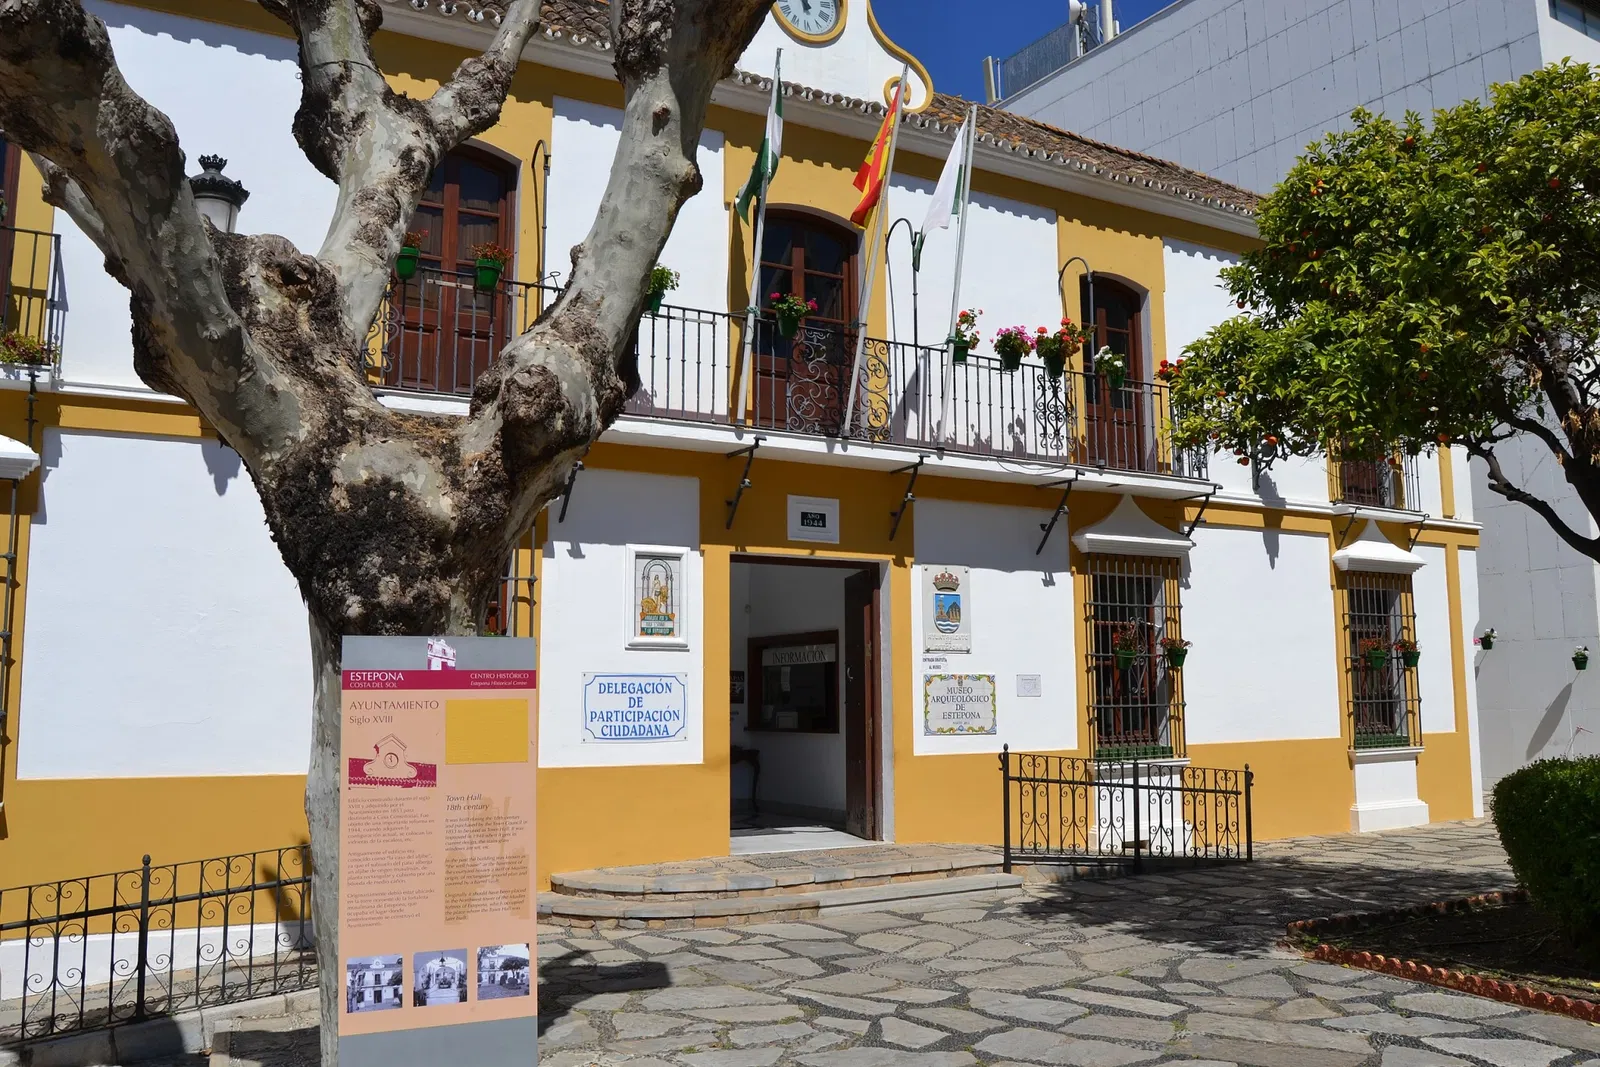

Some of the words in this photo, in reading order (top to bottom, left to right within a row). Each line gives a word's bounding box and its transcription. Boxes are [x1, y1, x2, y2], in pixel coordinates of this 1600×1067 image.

[804, 519, 823, 527] 1944
[350, 671, 404, 681] ESTEPONA
[598, 678, 672, 694] DELEGACIÓN
[628, 696, 643, 708] DE
[931, 694, 990, 704] ARQUEOLÓGICO
[349, 700, 440, 711] AYUNTAMIENTO
[590, 705, 680, 722] PARTICIPACIÓN
[942, 712, 981, 720] ESTEPONA
[349, 715, 370, 726] Siglo
[372, 715, 393, 723] XVIII
[601, 724, 669, 737] CIUDADANA
